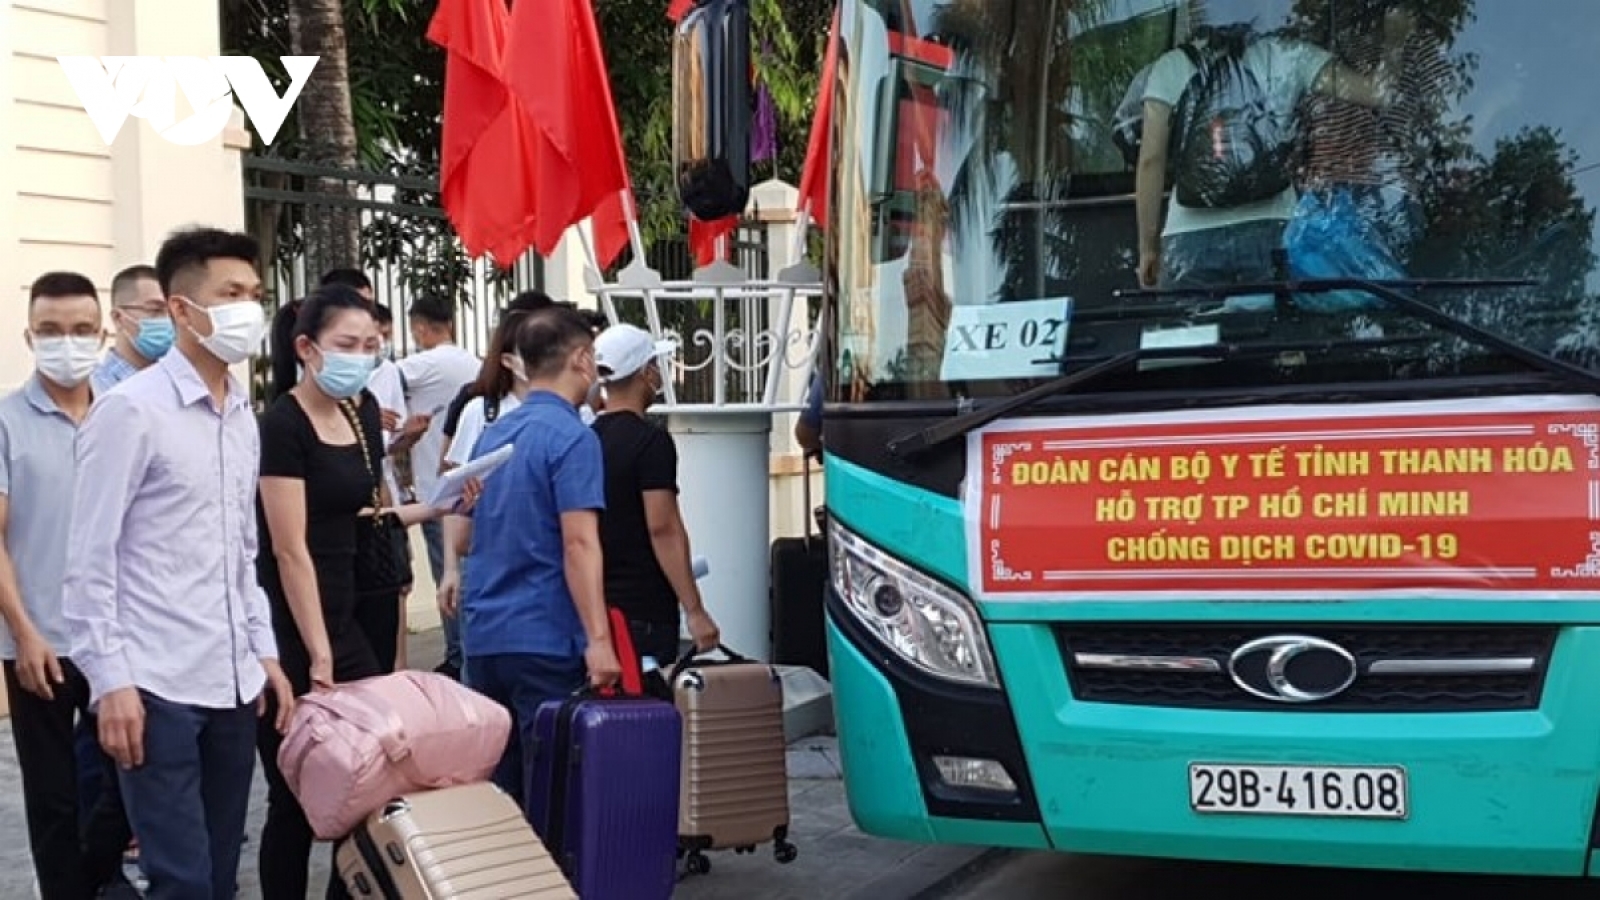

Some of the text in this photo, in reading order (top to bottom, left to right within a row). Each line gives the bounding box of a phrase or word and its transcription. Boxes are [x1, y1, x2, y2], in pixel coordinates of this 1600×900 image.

[952, 318, 1059, 351] XE 02
[1012, 441, 1574, 485] ĐOÀN CÁN BỘ Y TẾ TỈNH THANH HÓA
[1144, 494, 1203, 525] TRỢ
[1211, 495, 1249, 519] TP
[1313, 488, 1368, 518] CHÍ
[1378, 491, 1469, 516] MINH
[1107, 528, 1458, 565] CHỐNG DỊCH COVID-19
[1195, 769, 1398, 811] 29B-416.08
